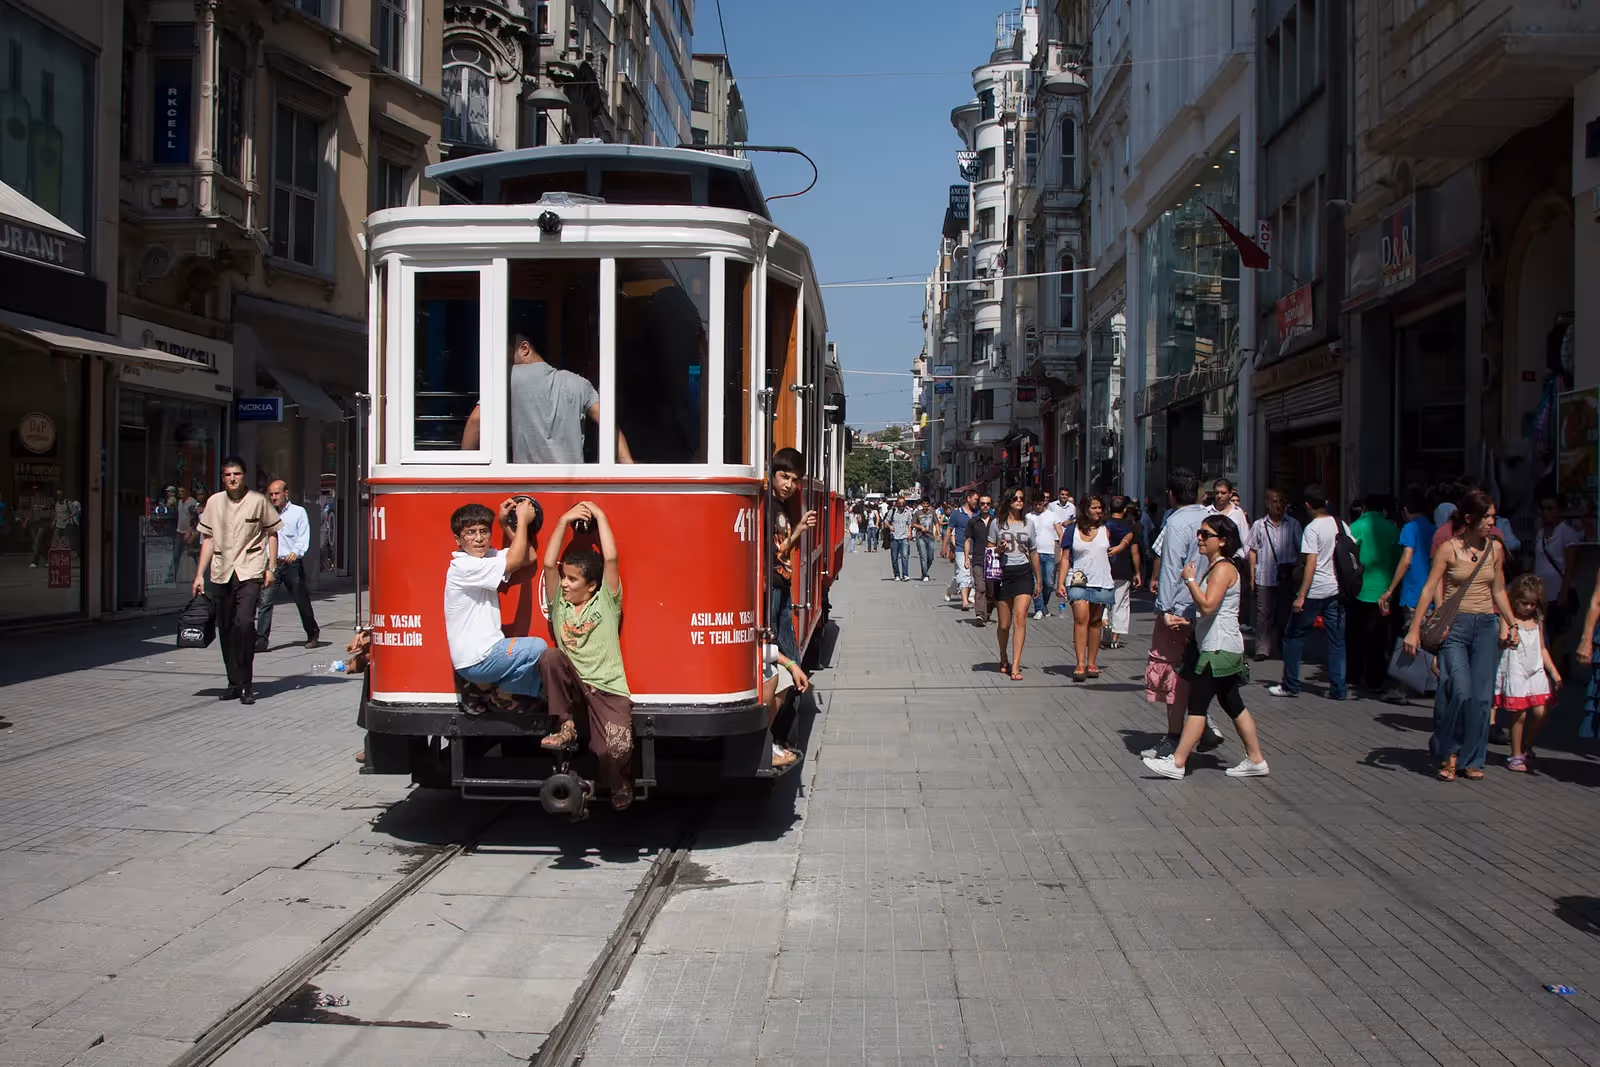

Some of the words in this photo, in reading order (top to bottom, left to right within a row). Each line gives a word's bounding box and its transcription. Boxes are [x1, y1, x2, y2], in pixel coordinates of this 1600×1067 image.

[1382, 225, 1410, 266] D&R
[238, 403, 273, 412] NOKIA
[733, 508, 755, 542] 411
[390, 614, 422, 629] YASAK
[690, 612, 725, 626] ASILMAK
[689, 631, 706, 646] VE
